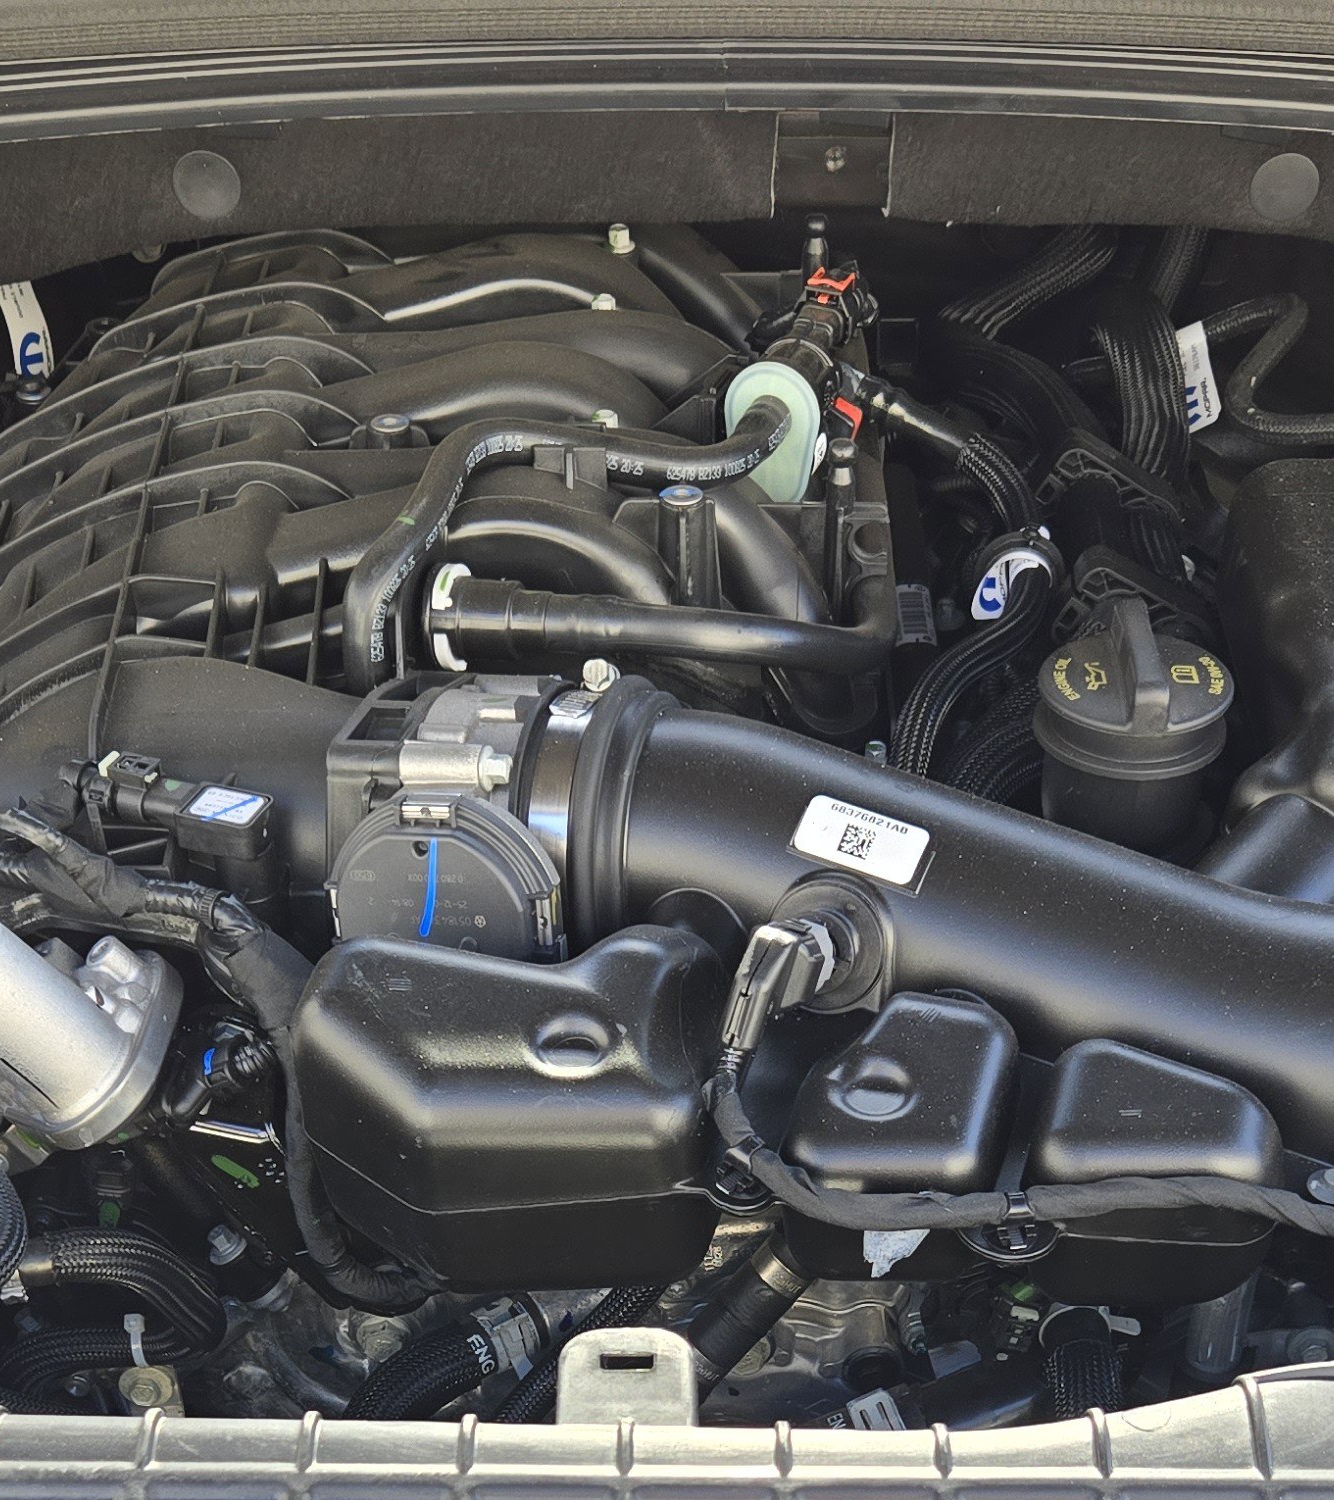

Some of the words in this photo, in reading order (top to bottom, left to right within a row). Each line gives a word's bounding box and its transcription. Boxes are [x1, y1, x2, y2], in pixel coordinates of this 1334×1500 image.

[1055, 657, 1072, 670] OIL
[1053, 670, 1081, 701] ENGINE
[466, 1334, 495, 1375] ENG
